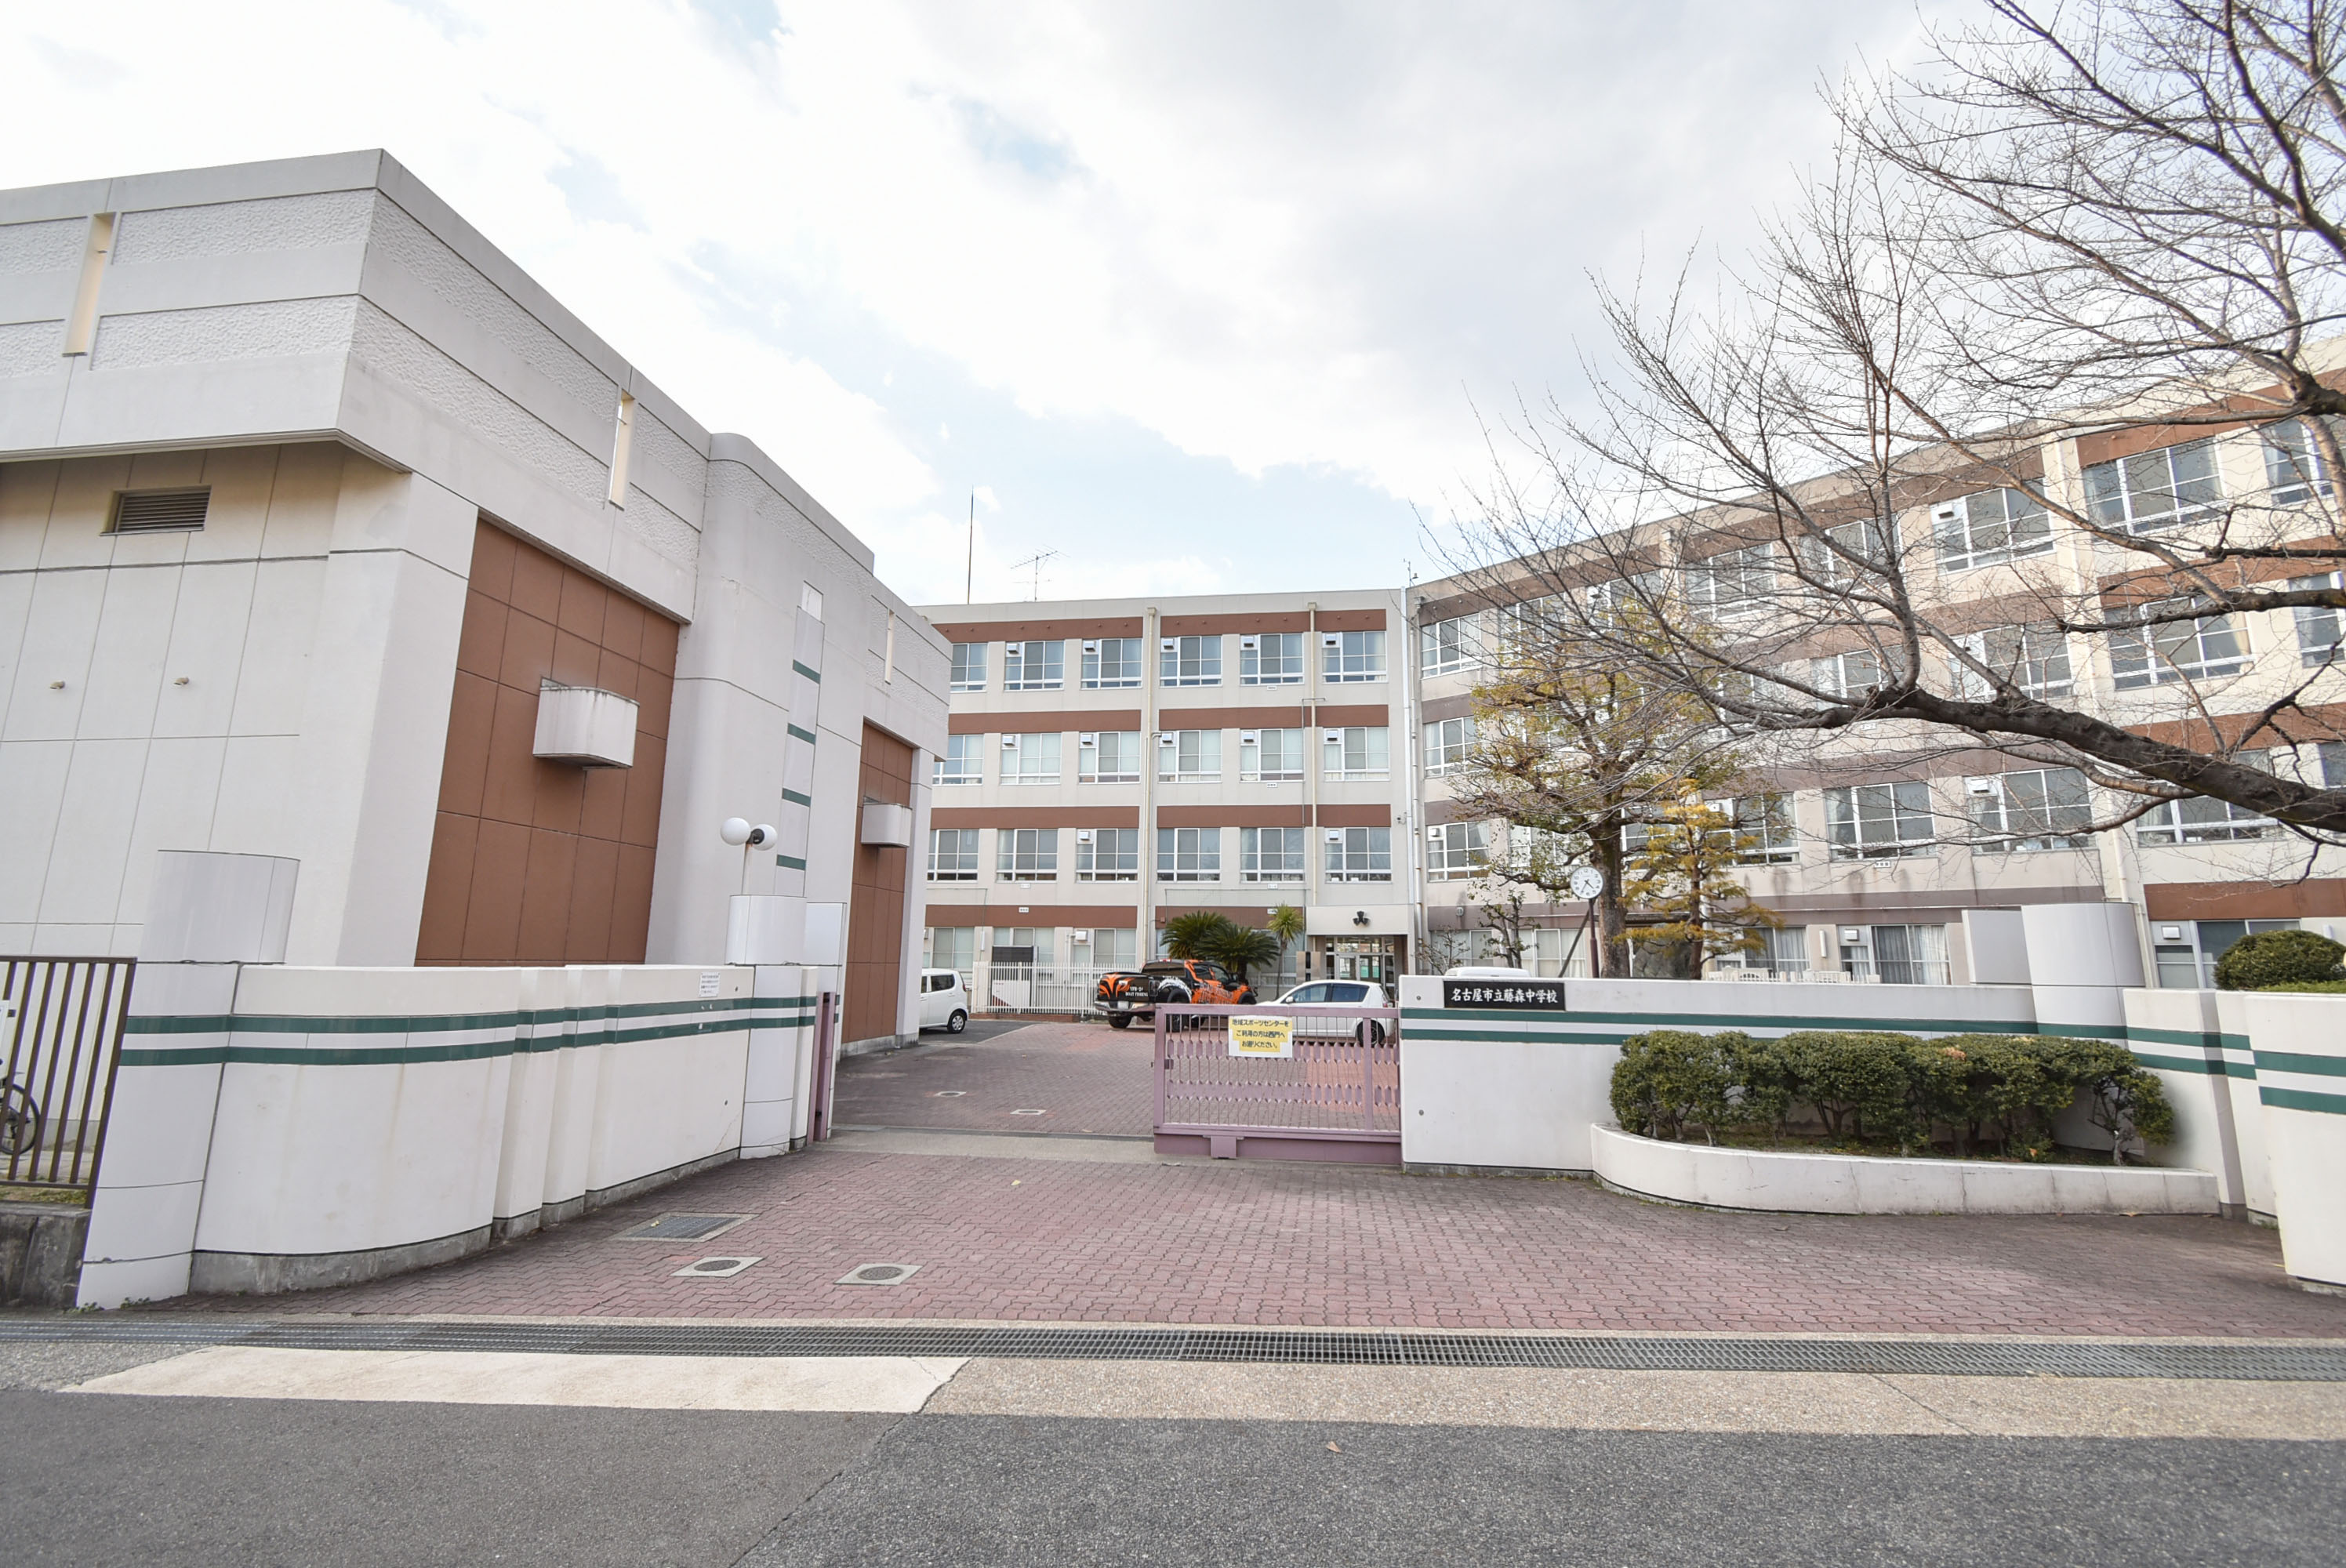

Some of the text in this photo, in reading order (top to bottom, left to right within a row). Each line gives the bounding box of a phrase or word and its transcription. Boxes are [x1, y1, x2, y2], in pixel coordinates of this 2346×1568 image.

[1451, 988, 1558, 1004] 名古屋市立藤森中学校
